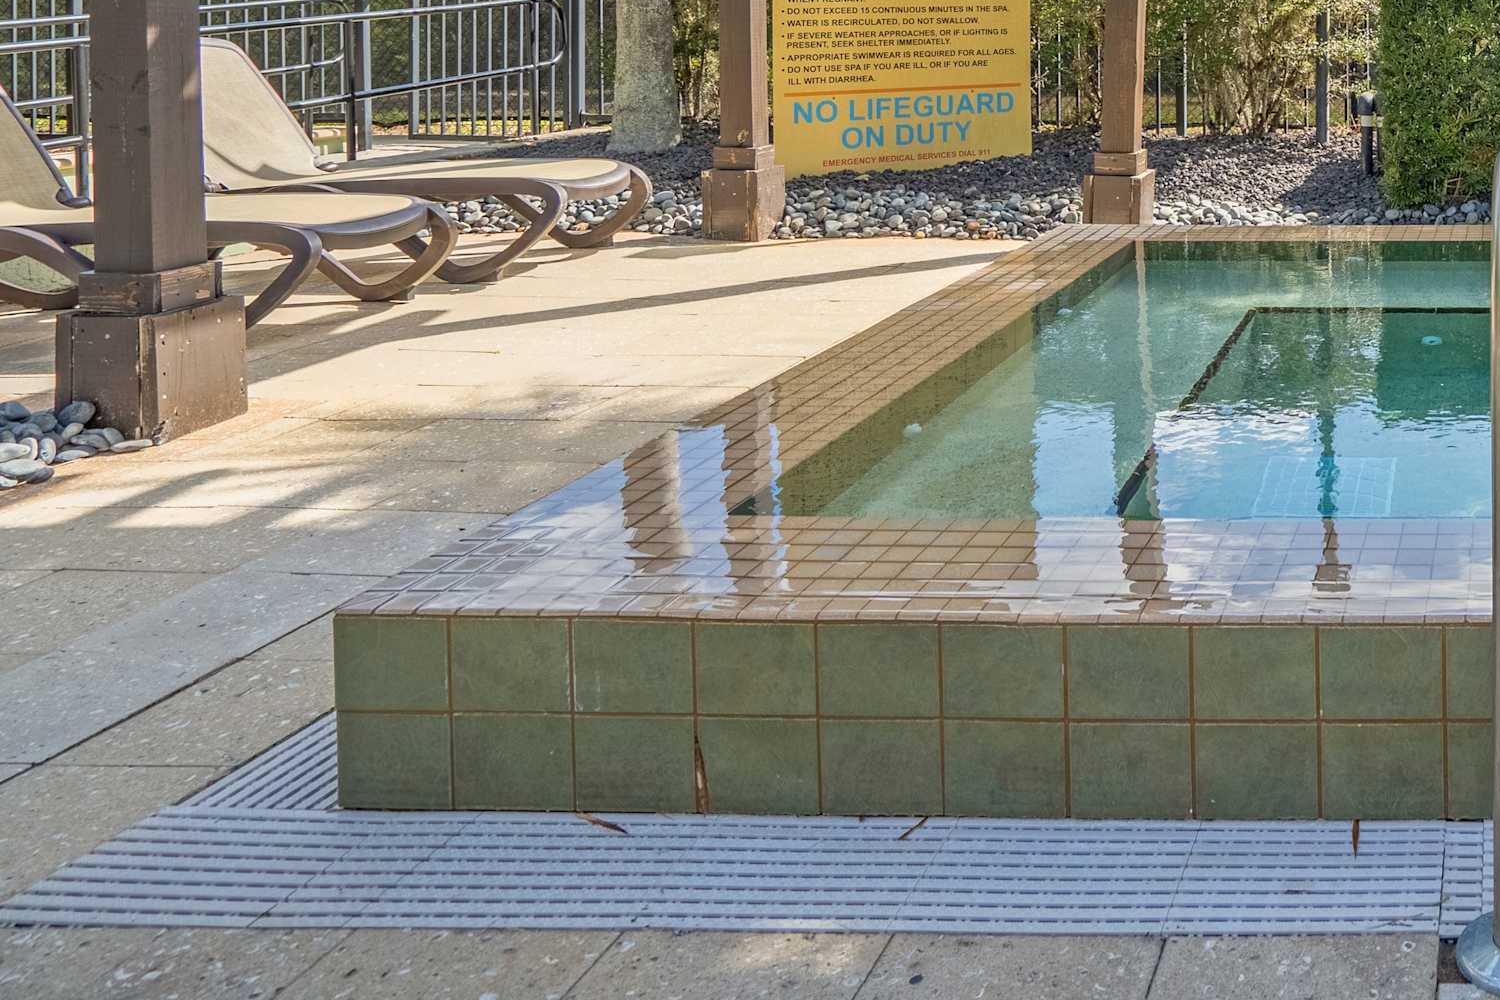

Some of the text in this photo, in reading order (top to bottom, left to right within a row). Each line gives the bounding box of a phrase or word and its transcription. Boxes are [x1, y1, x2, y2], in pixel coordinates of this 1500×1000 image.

[787, 19, 818, 28] WATER
[820, 19, 829, 27] IS
[902, 17, 915, 25] DO
[916, 17, 934, 25] NOT
[831, 40, 854, 48] SEEK
[856, 39, 894, 48] SHELTER
[787, 52, 850, 62] APPROPRIATE
[852, 51, 900, 60] SWIMWEAR
[903, 51, 911, 59] IS
[913, 49, 956, 58] REQUIRED
[957, 49, 974, 57] FOR
[976, 48, 991, 56] ALL
[794, 92, 1014, 124] NO LIFEGUARD
[842, 120, 972, 149] ON DUTY
